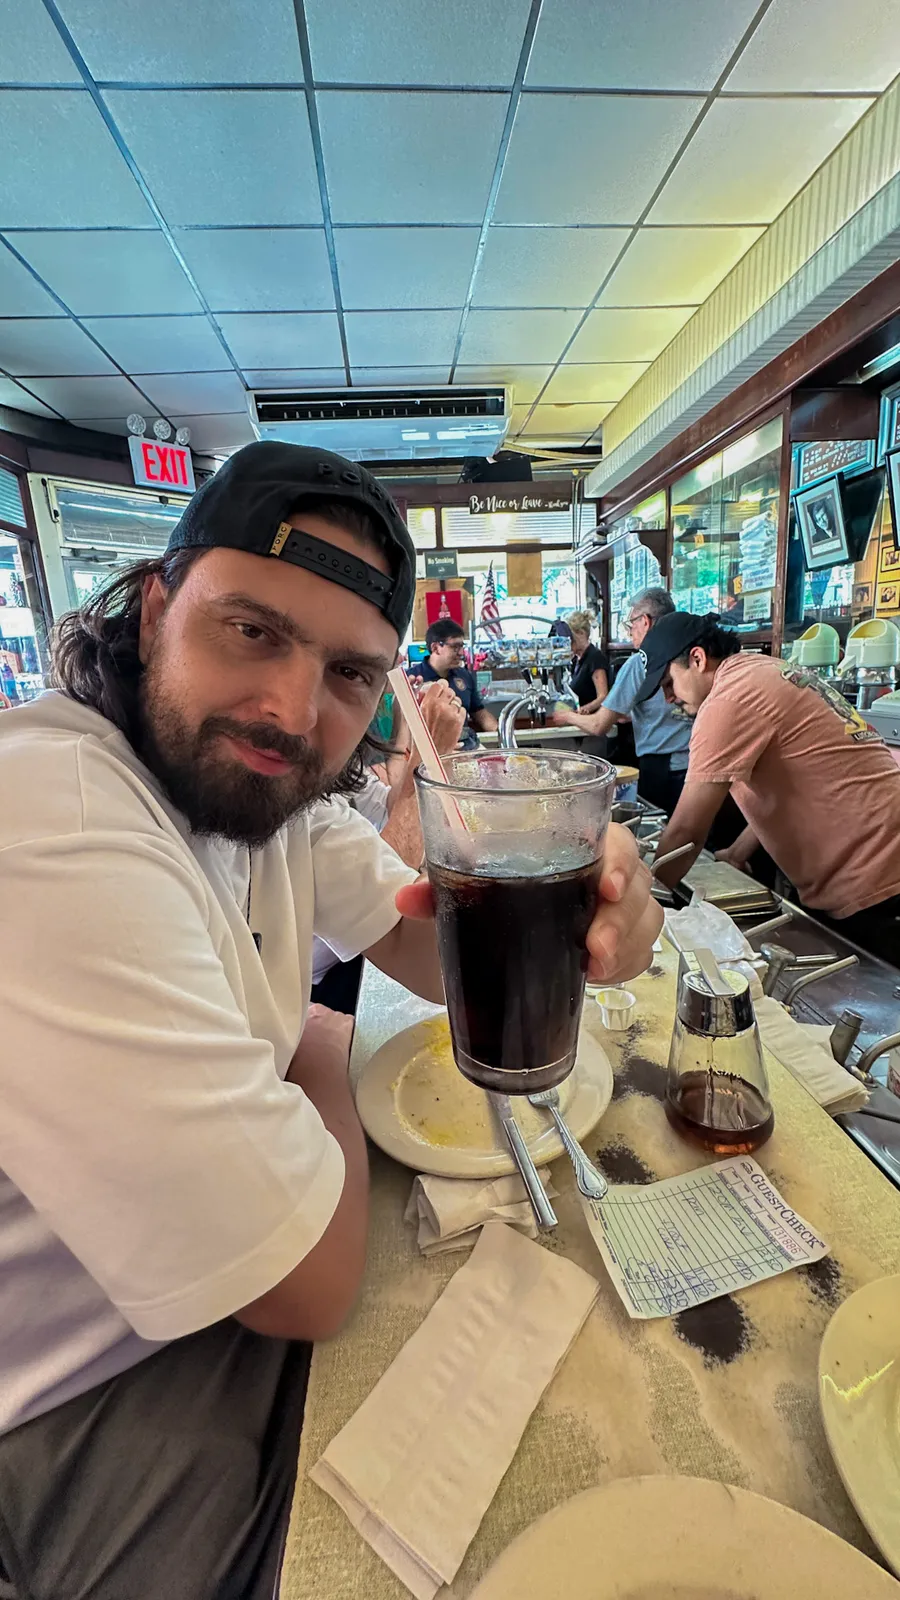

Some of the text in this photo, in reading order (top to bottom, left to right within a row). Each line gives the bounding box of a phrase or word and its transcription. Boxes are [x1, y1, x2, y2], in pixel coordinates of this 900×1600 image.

[141, 442, 188, 486] EXIT
[470, 495, 485, 513] Be
[486, 495, 507, 512] Nice
[508, 501, 519, 511] or
[521, 495, 543, 510] Leave
[427, 556, 455, 565] No Smoking
[774, 1229, 801, 1255] 31886
